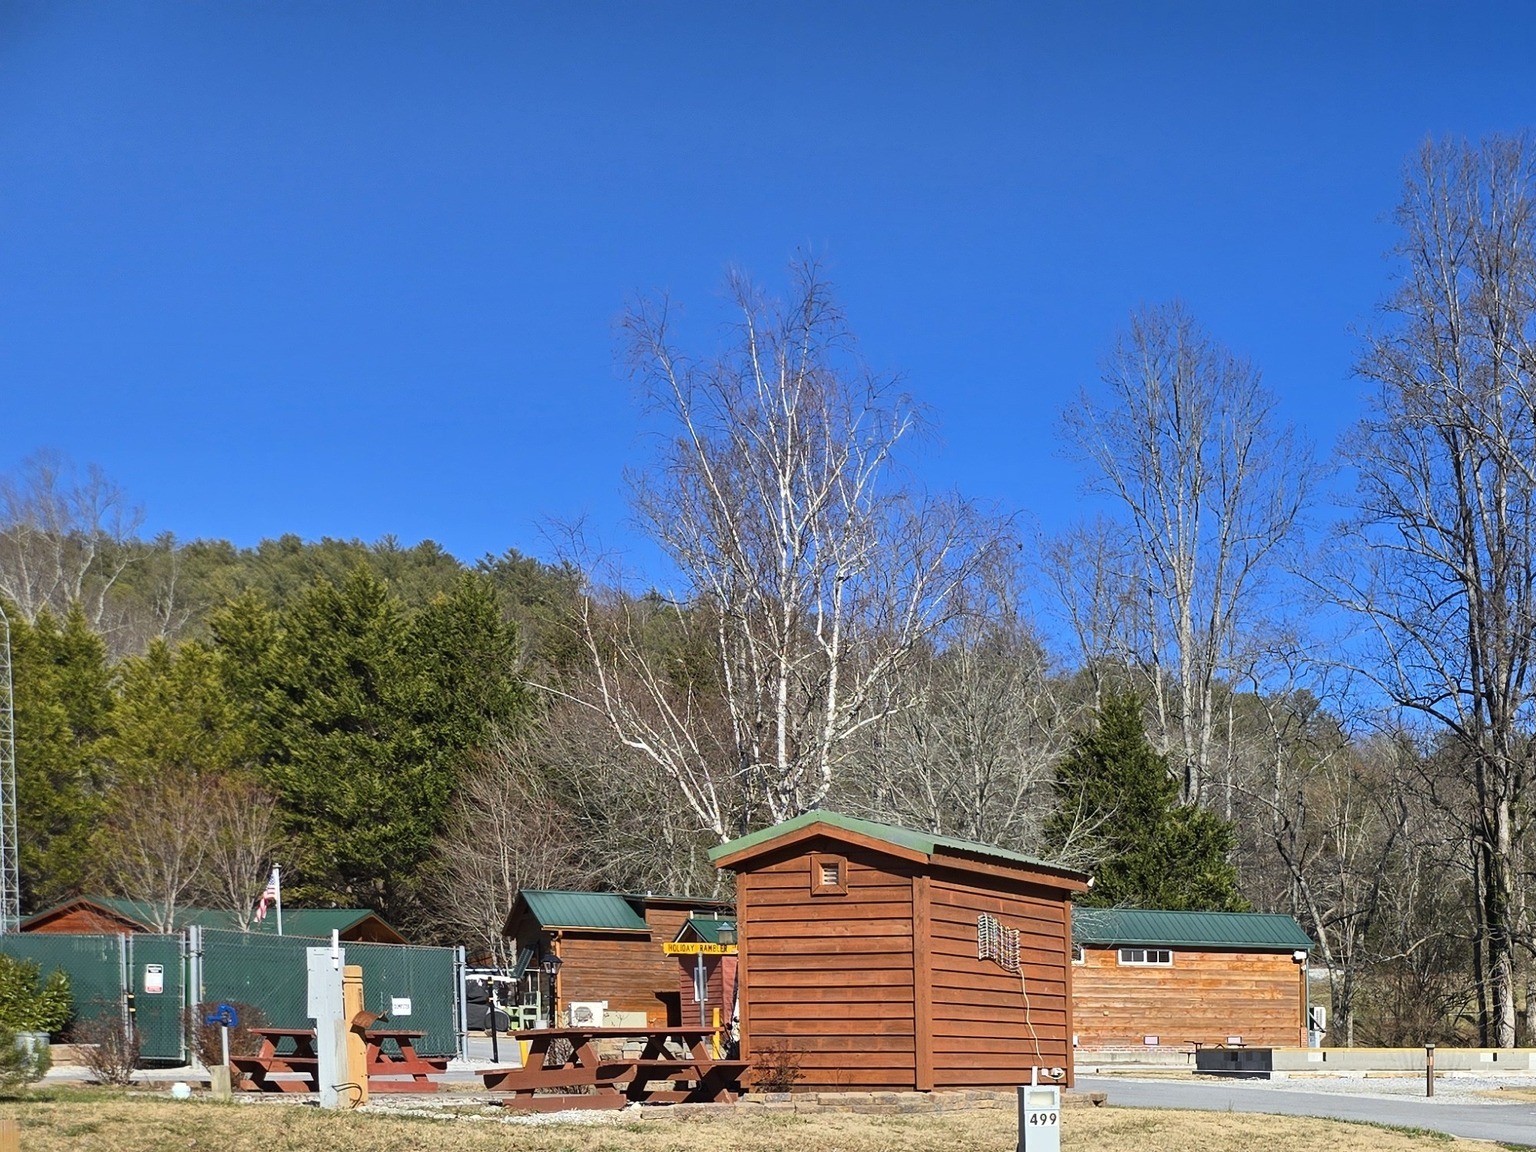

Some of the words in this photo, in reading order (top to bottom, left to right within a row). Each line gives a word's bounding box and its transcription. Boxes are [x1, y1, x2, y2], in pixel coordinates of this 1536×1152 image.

[667, 944, 695, 953] HOLIDAY
[699, 944, 728, 953] RAMBLER
[1030, 1112, 1057, 1125] 499
